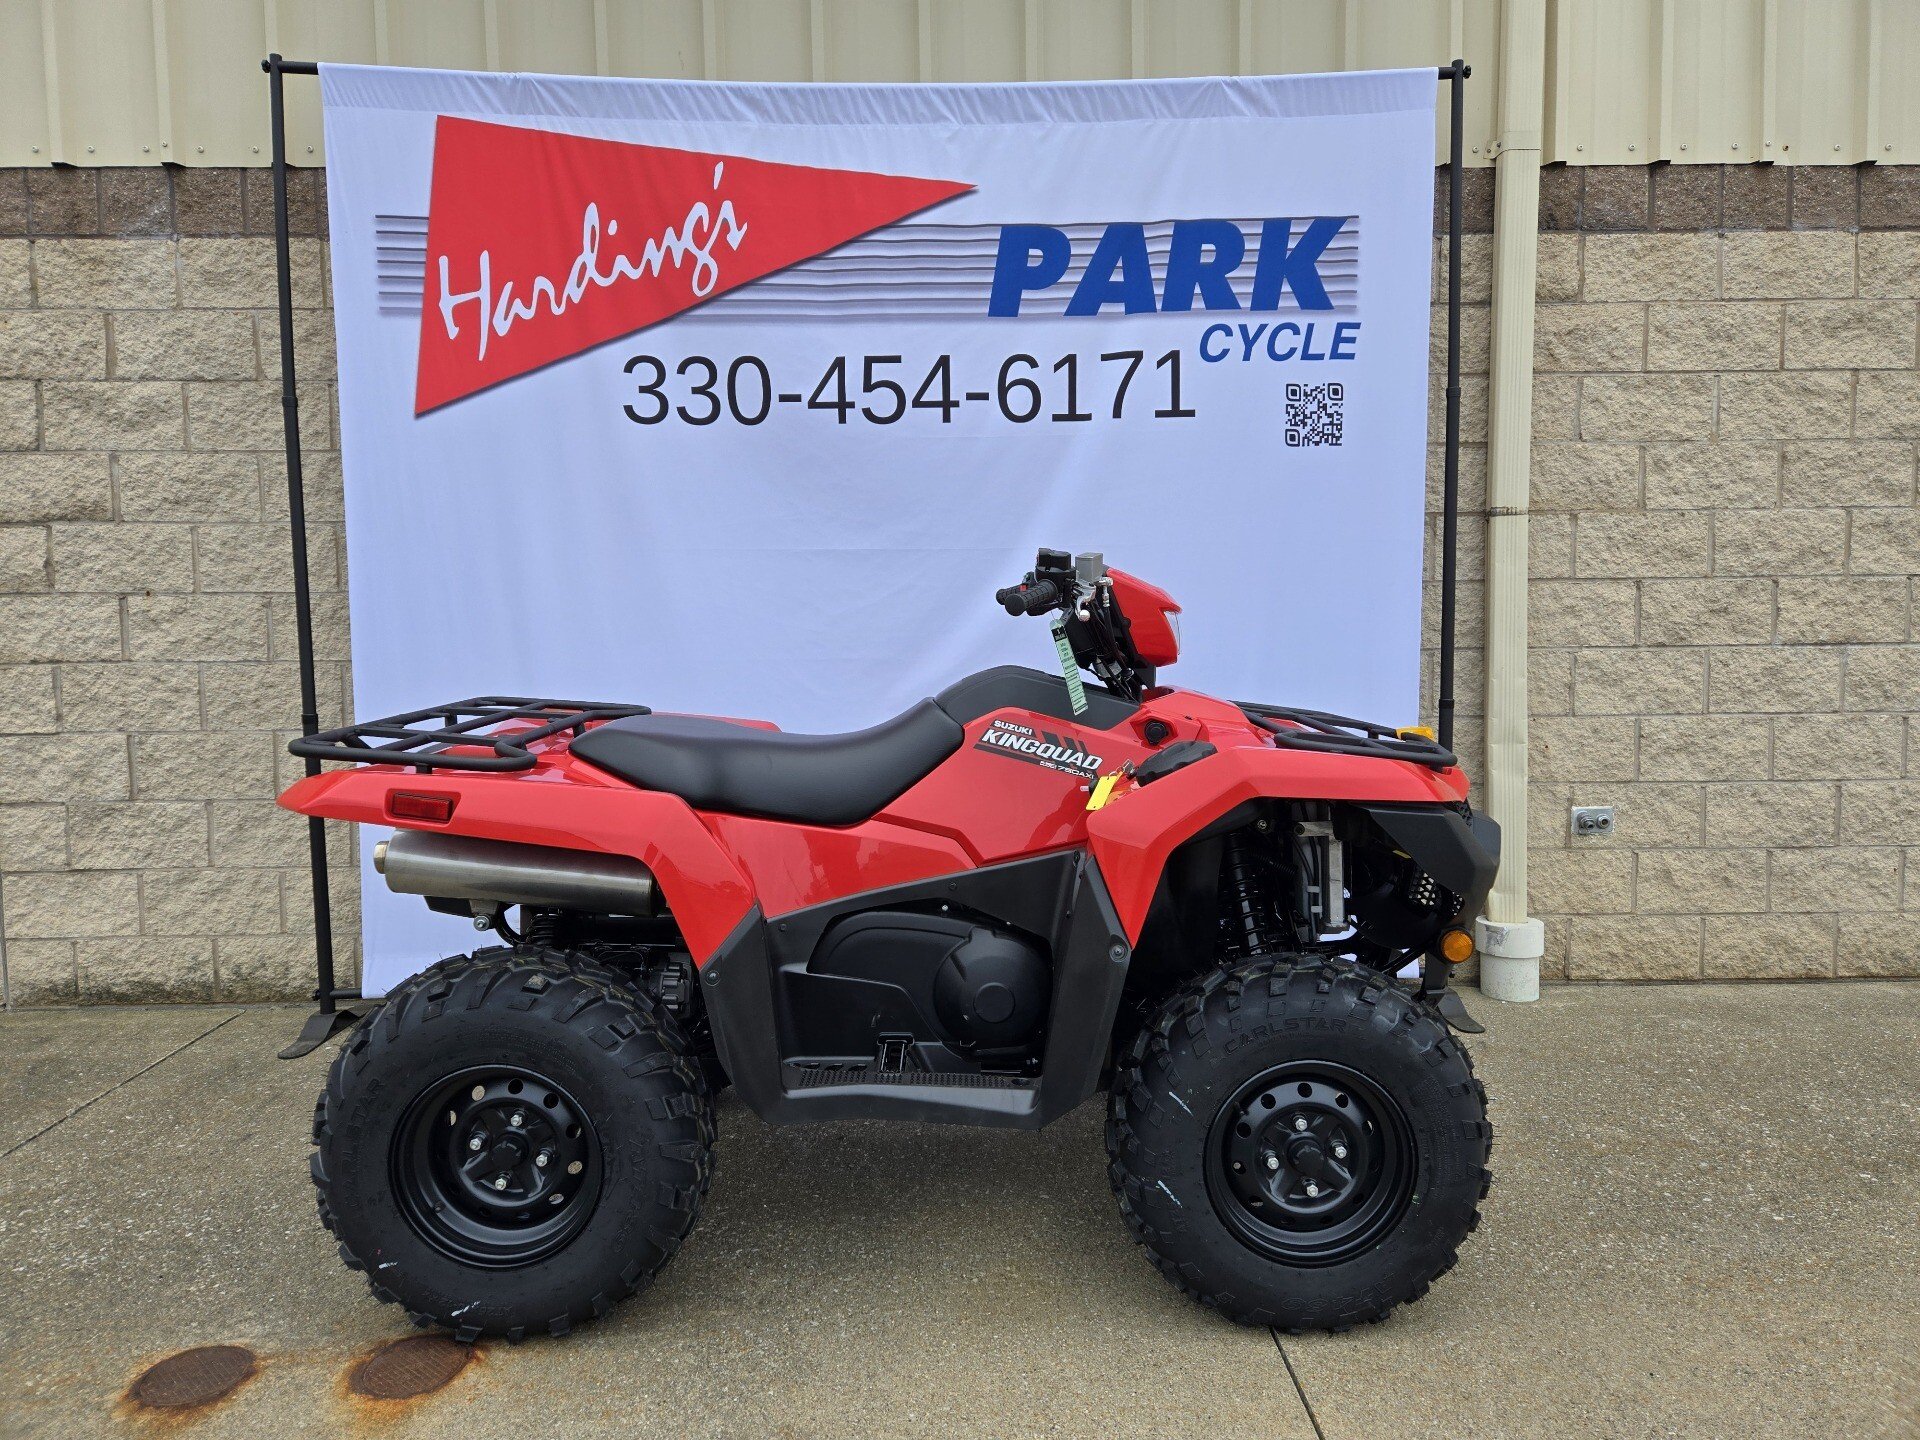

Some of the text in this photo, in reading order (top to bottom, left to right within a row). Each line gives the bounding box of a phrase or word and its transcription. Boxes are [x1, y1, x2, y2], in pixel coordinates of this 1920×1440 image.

[988, 215, 1348, 318] PARK
[1199, 322, 1362, 363] CYCLE
[622, 349, 1196, 426] 330-454-6171
[993, 720, 1033, 735] SUZUKI
[982, 730, 1103, 770] KINGQUAD
